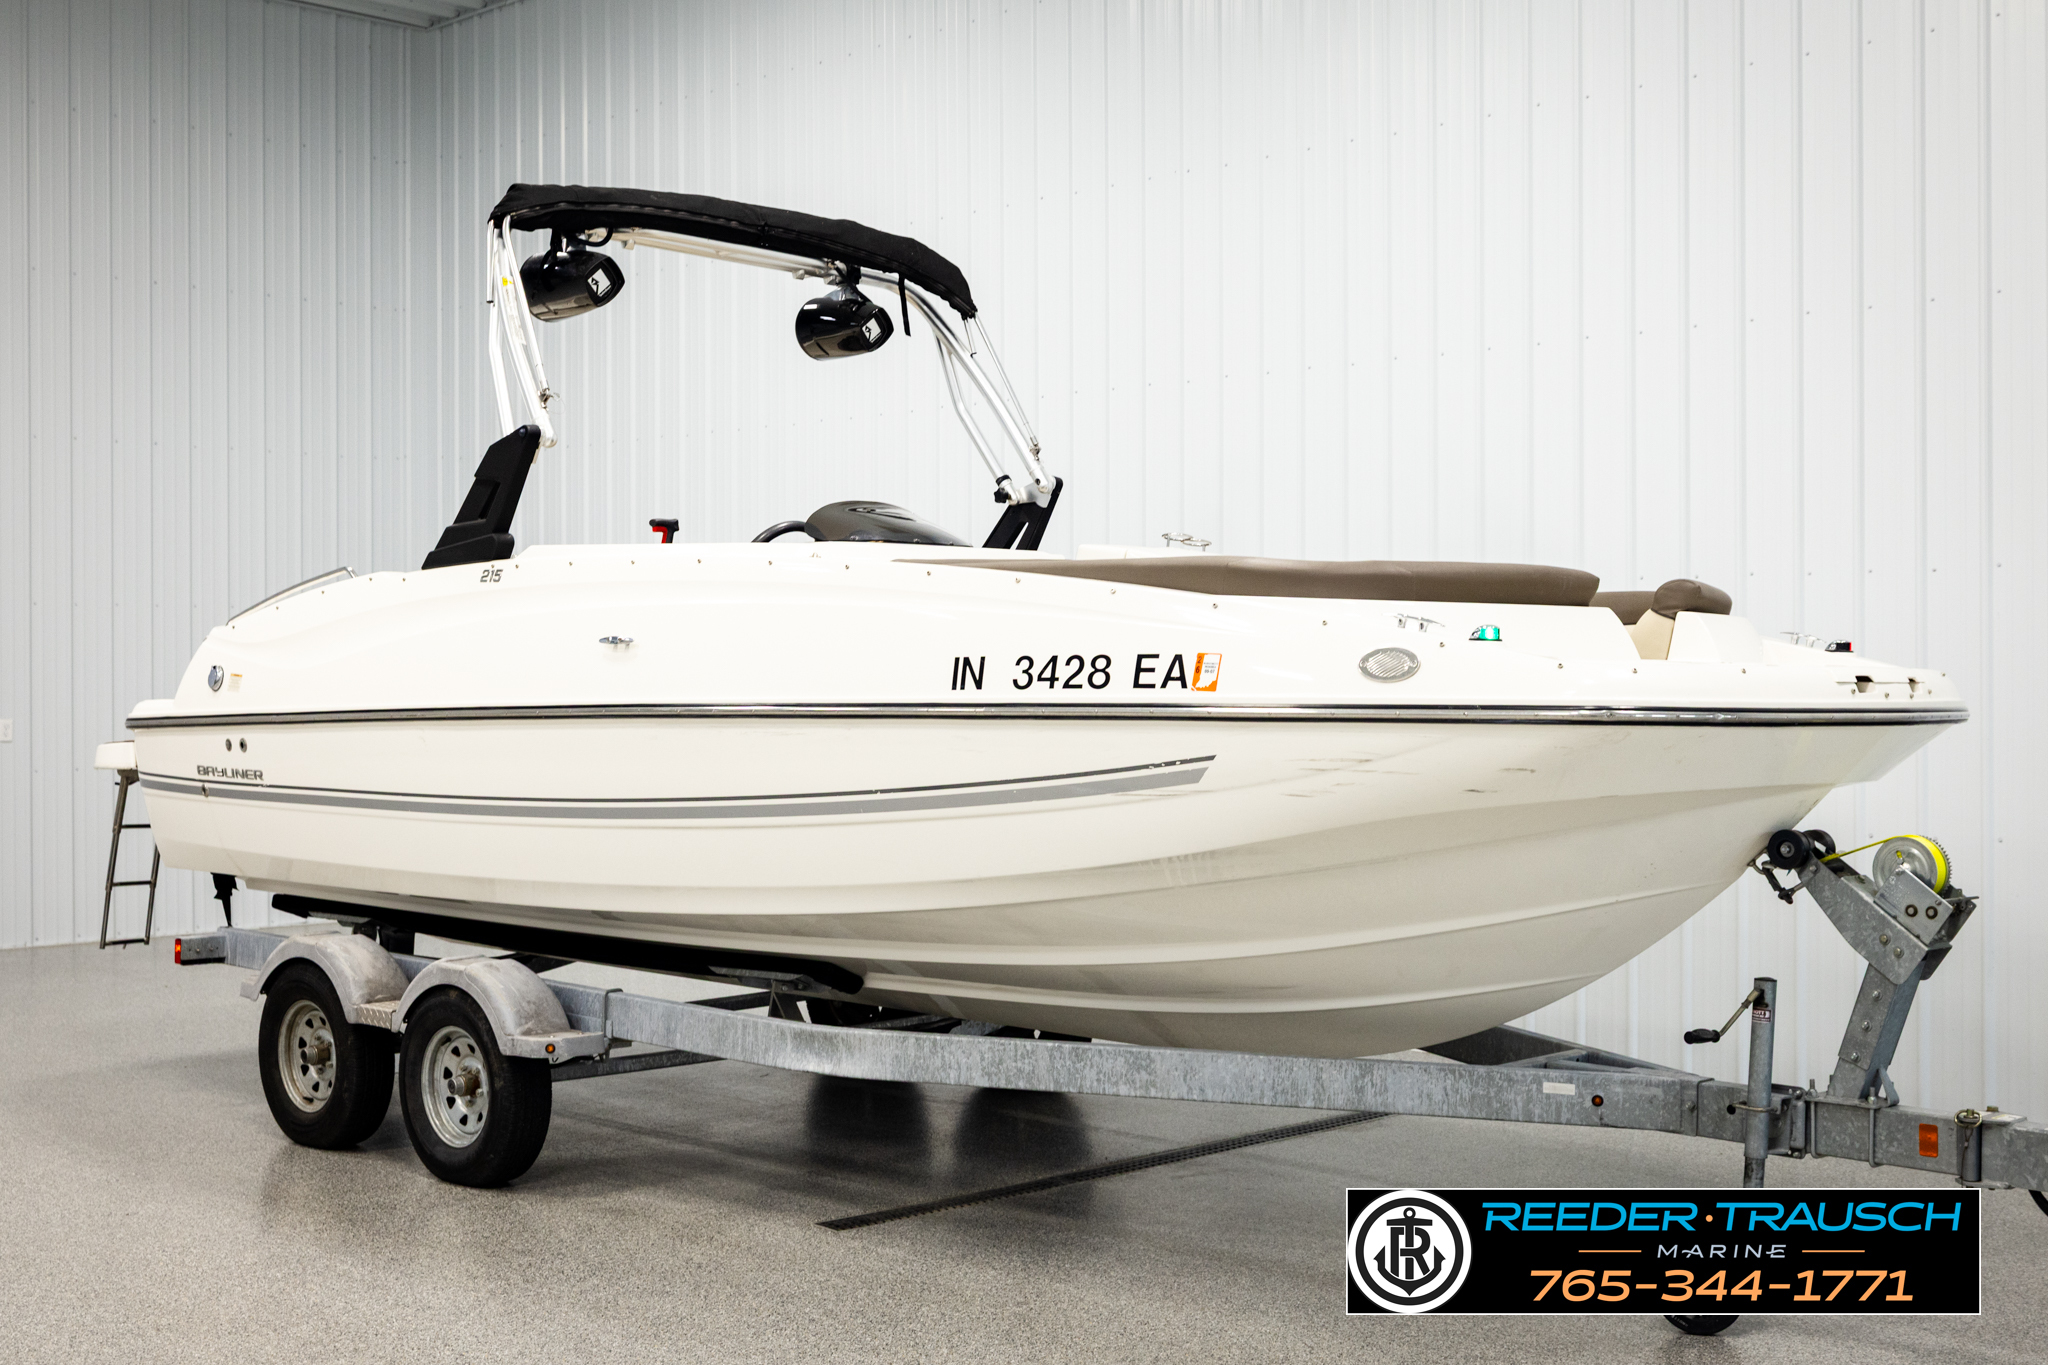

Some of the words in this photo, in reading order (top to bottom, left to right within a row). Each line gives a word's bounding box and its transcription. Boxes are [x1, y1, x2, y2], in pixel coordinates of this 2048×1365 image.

[480, 569, 503, 582] 215
[951, 657, 986, 691] IN
[1012, 655, 1112, 691] 3428
[1132, 653, 1188, 689] EA
[196, 764, 264, 781] BAYLINER
